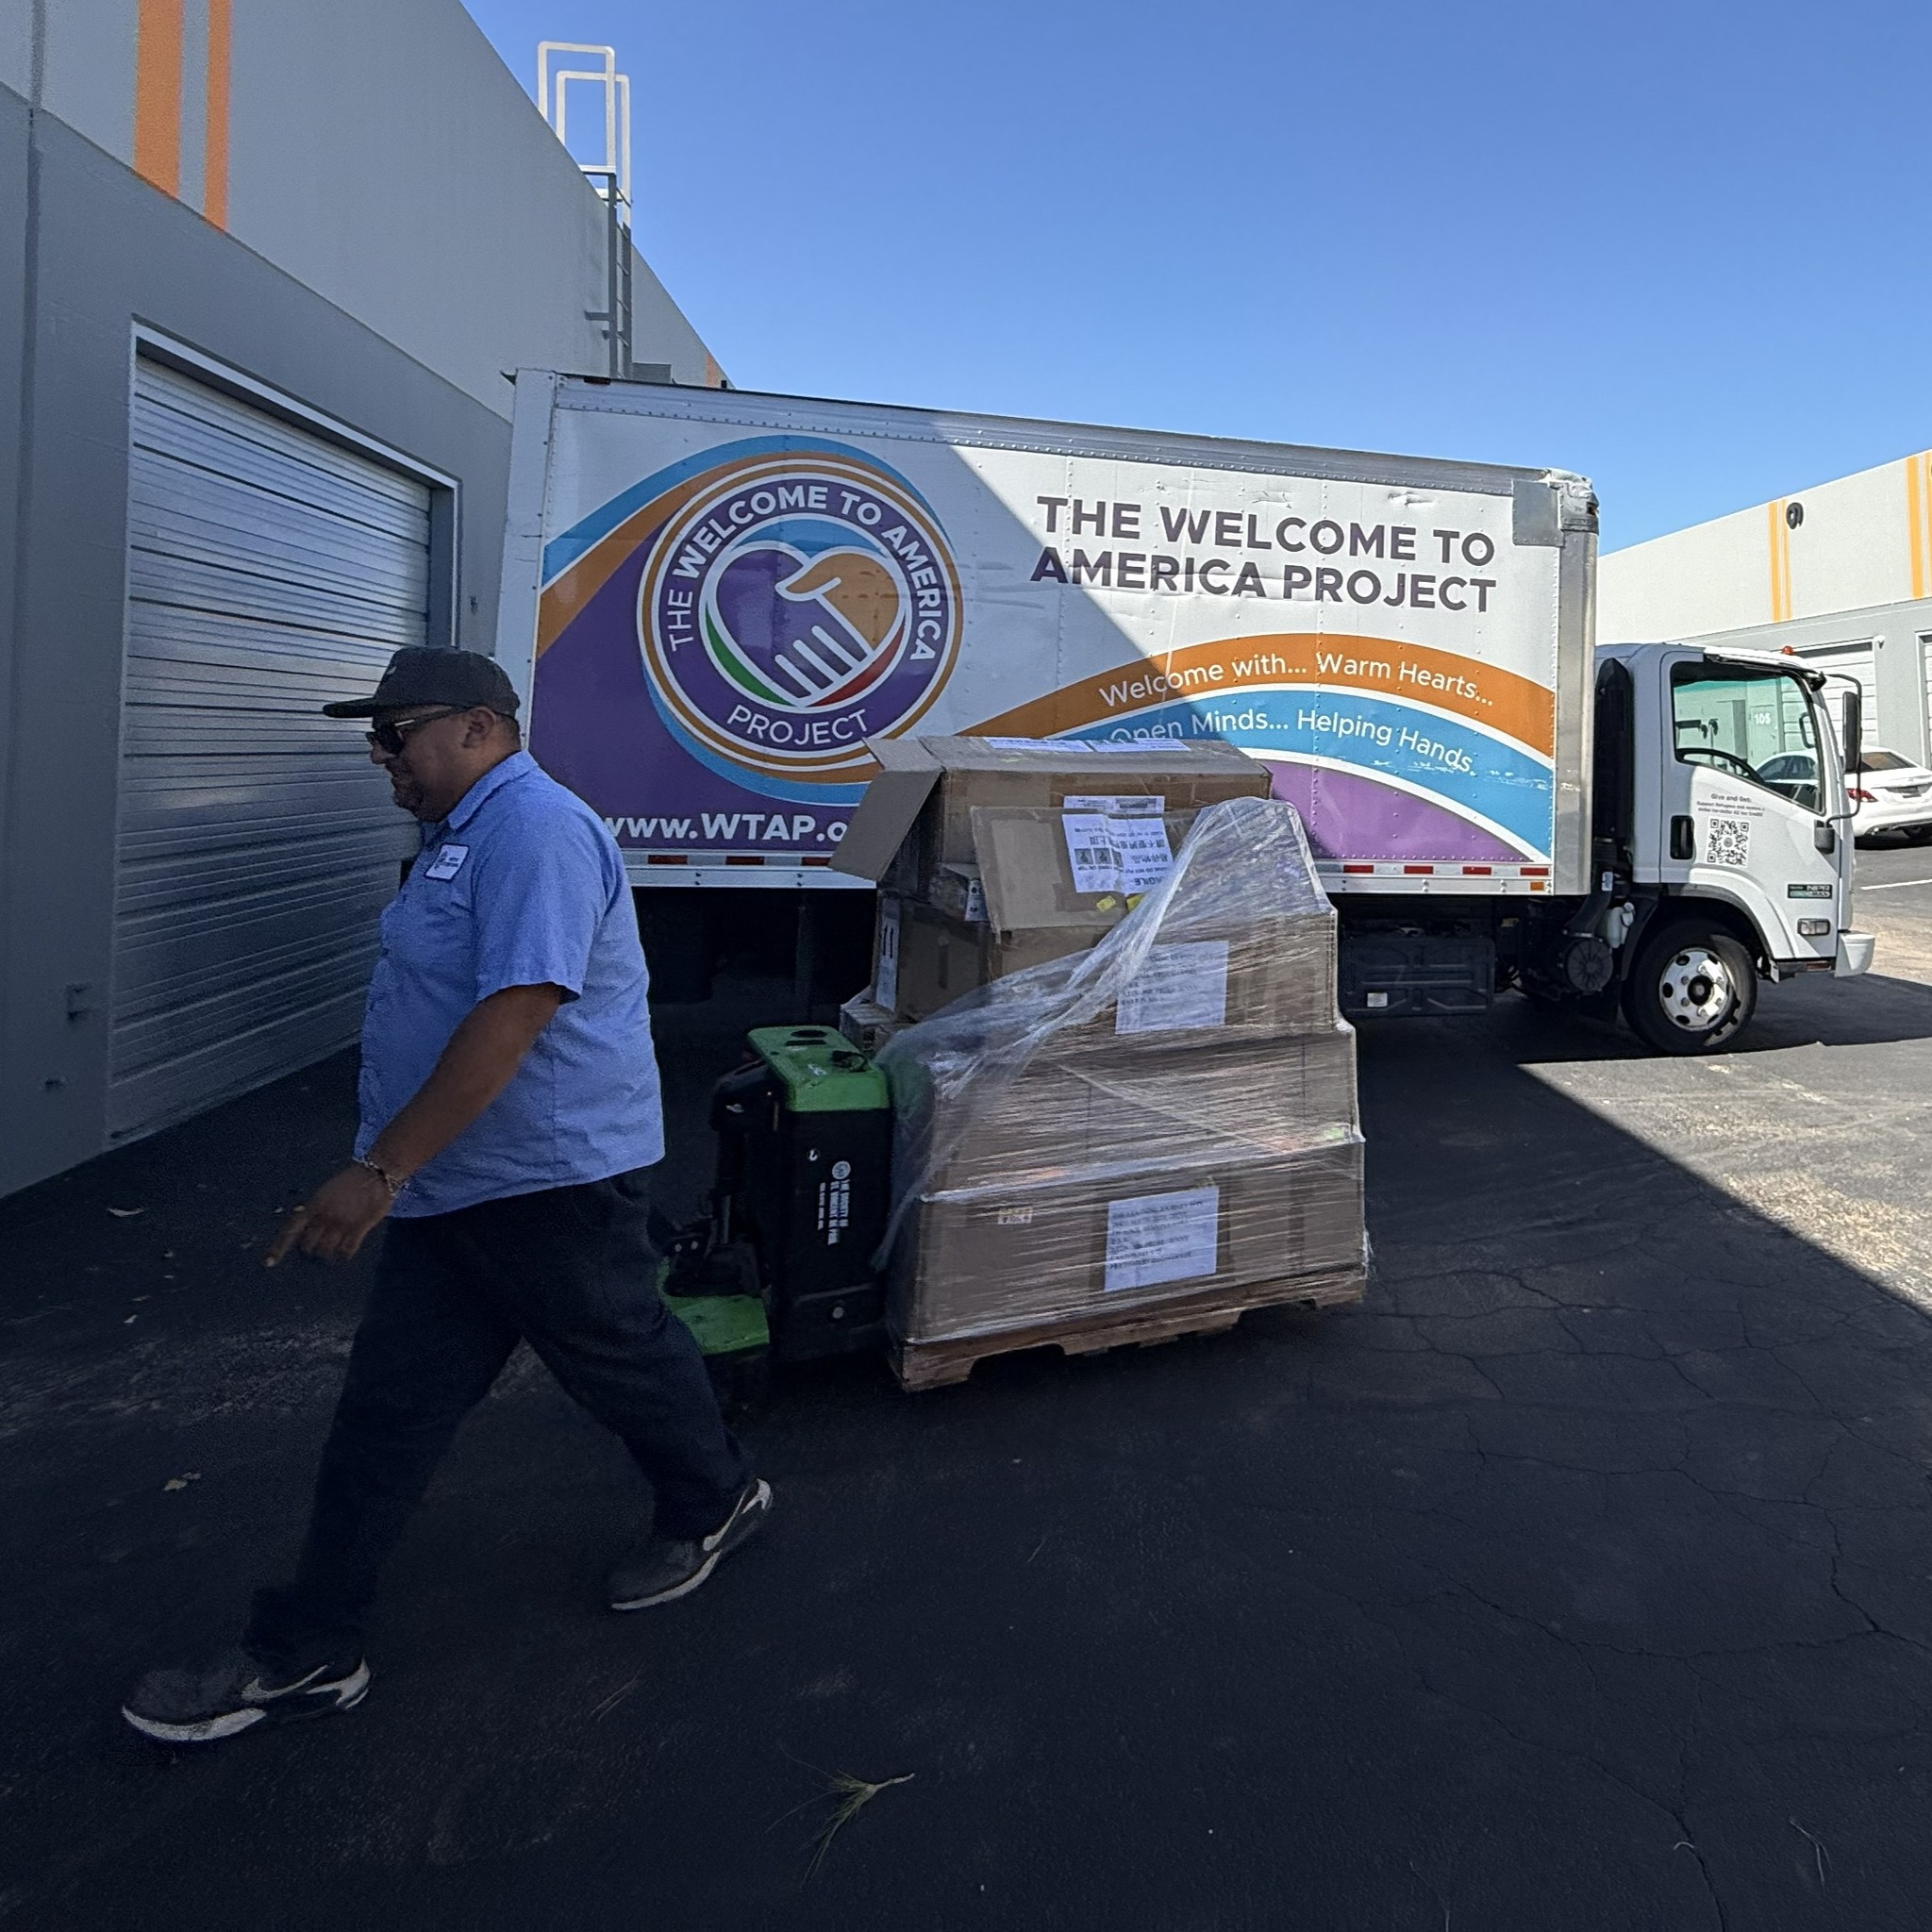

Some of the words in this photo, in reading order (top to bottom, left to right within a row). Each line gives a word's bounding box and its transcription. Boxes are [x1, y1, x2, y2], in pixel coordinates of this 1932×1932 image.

[673, 486, 828, 580] WELCOME
[840, 490, 883, 526] TO
[1036, 495, 1141, 540] THE
[1159, 506, 1416, 561] WELCOME
[1433, 528, 1496, 567] TO
[880, 525, 941, 662] AMERICA
[1029, 546, 1268, 598] AMERICA
[1282, 564, 1497, 613] PROJECT
[667, 589, 695, 652] THE
[1099, 660, 1224, 708] Welcome
[1230, 654, 1307, 678] with...
[1317, 652, 1391, 680] Warm
[1400, 662, 1494, 707] Hearts...
[725, 704, 870, 746] PROJECT
[1191, 708, 1289, 735] Minds...
[1297, 708, 1393, 748] Helping
[1755, 712, 1772, 724] 105
